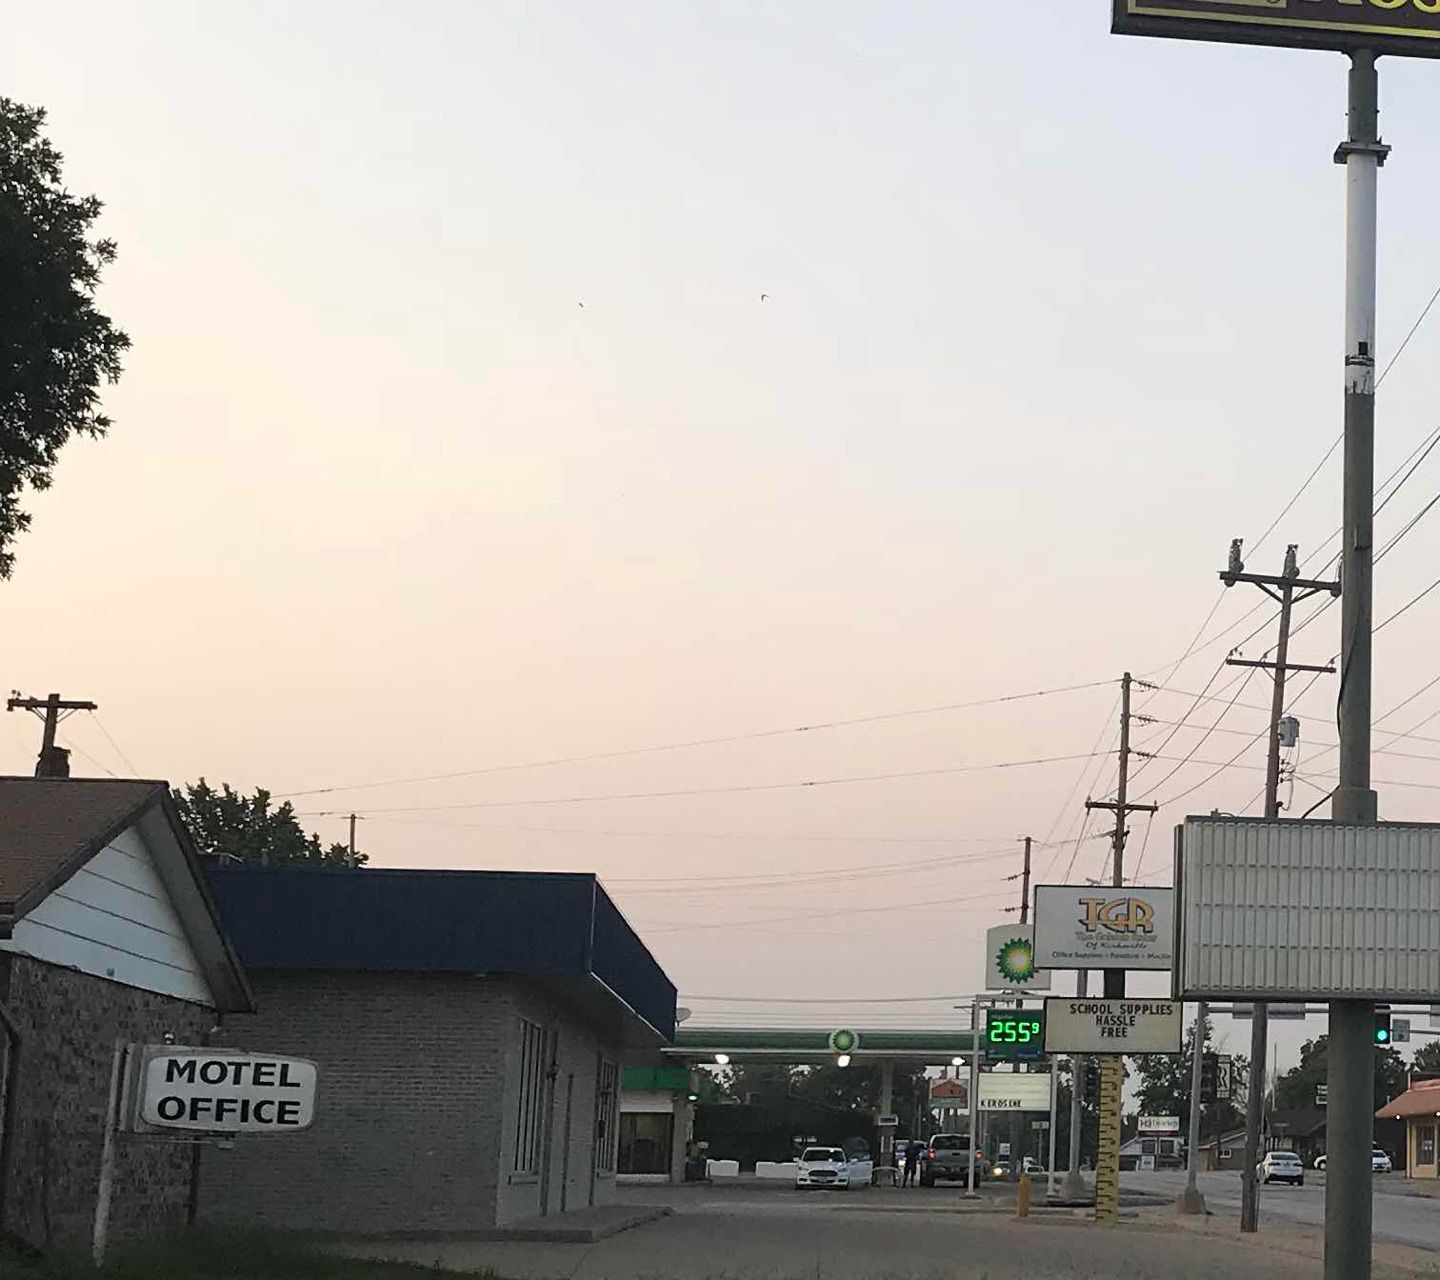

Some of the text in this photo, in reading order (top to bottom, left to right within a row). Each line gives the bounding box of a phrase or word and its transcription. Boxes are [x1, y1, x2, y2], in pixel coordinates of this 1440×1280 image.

[1069, 1003, 1173, 1016] SCHOOL SUPPLIES
[1095, 1015, 1136, 1027] HASSLE
[1101, 1026, 1128, 1038] FREE
[165, 1058, 301, 1088] MOTEL
[157, 1096, 301, 1125] OFFICE
